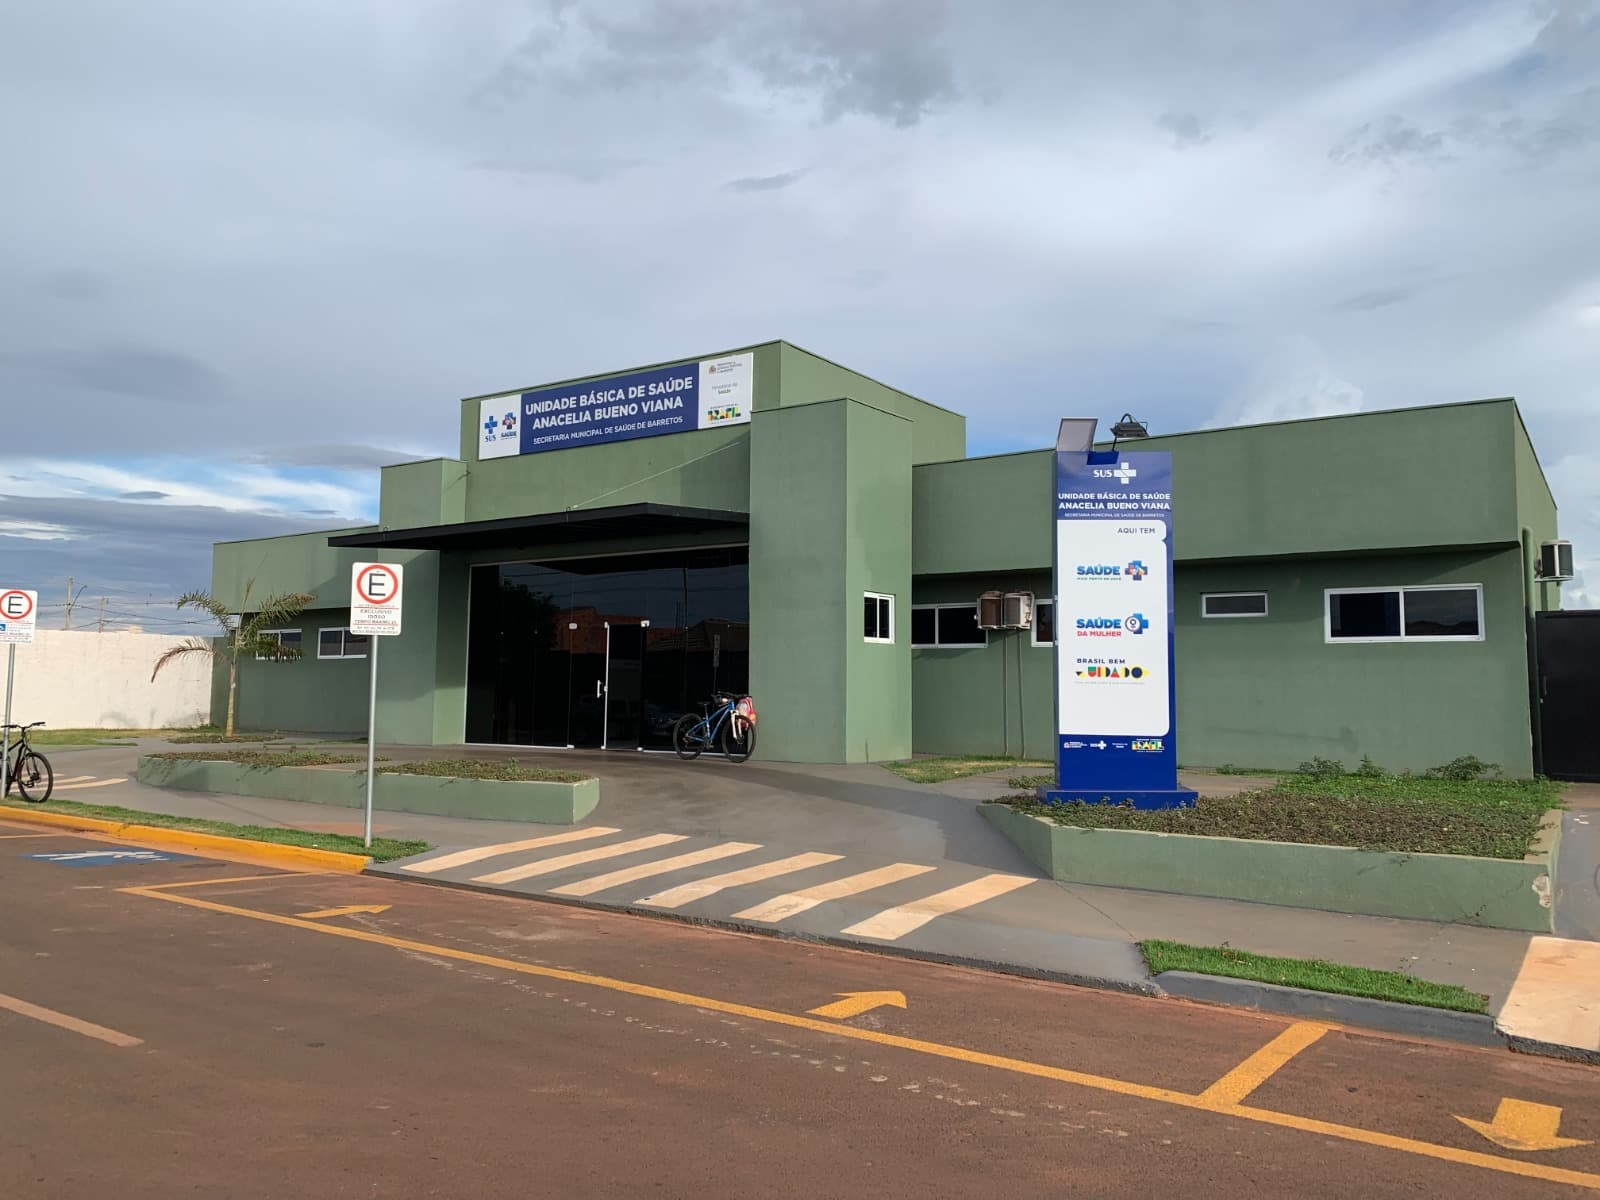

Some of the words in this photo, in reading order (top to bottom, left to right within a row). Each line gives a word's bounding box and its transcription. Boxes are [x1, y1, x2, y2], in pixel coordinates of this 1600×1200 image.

[525, 396, 577, 415] UNIDADE
[579, 389, 625, 406] BÁSICA
[628, 385, 646, 399] DE
[648, 376, 693, 396] SAÚDE
[532, 410, 592, 430] ANACELIA
[594, 403, 638, 420] BUENO
[641, 396, 684, 413] VIANA
[533, 433, 570, 445] SECRETARIA
[571, 428, 603, 439] MUNICIPAL
[604, 426, 613, 434] DE
[636, 421, 646, 429] DE
[647, 416, 683, 428] BARRETOS
[484, 434, 496, 442] SUS
[1093, 469, 1112, 478] SUS
[1058, 492, 1095, 500] UNIDADE
[1096, 491, 1128, 500] BÁSICA
[1129, 492, 1141, 500] DE
[1142, 491, 1171, 500] SAÚDE
[1058, 502, 1105, 510] ANACELIA
[1107, 502, 1139, 510] BUENO
[1139, 502, 1171, 510] VIANA
[1117, 527, 1137, 535] AQUI
[1076, 563, 1121, 575] SAÚDE
[368, 573, 386, 596] E
[8, 596, 24, 614] E
[1076, 616, 1122, 629] SAÚDE
